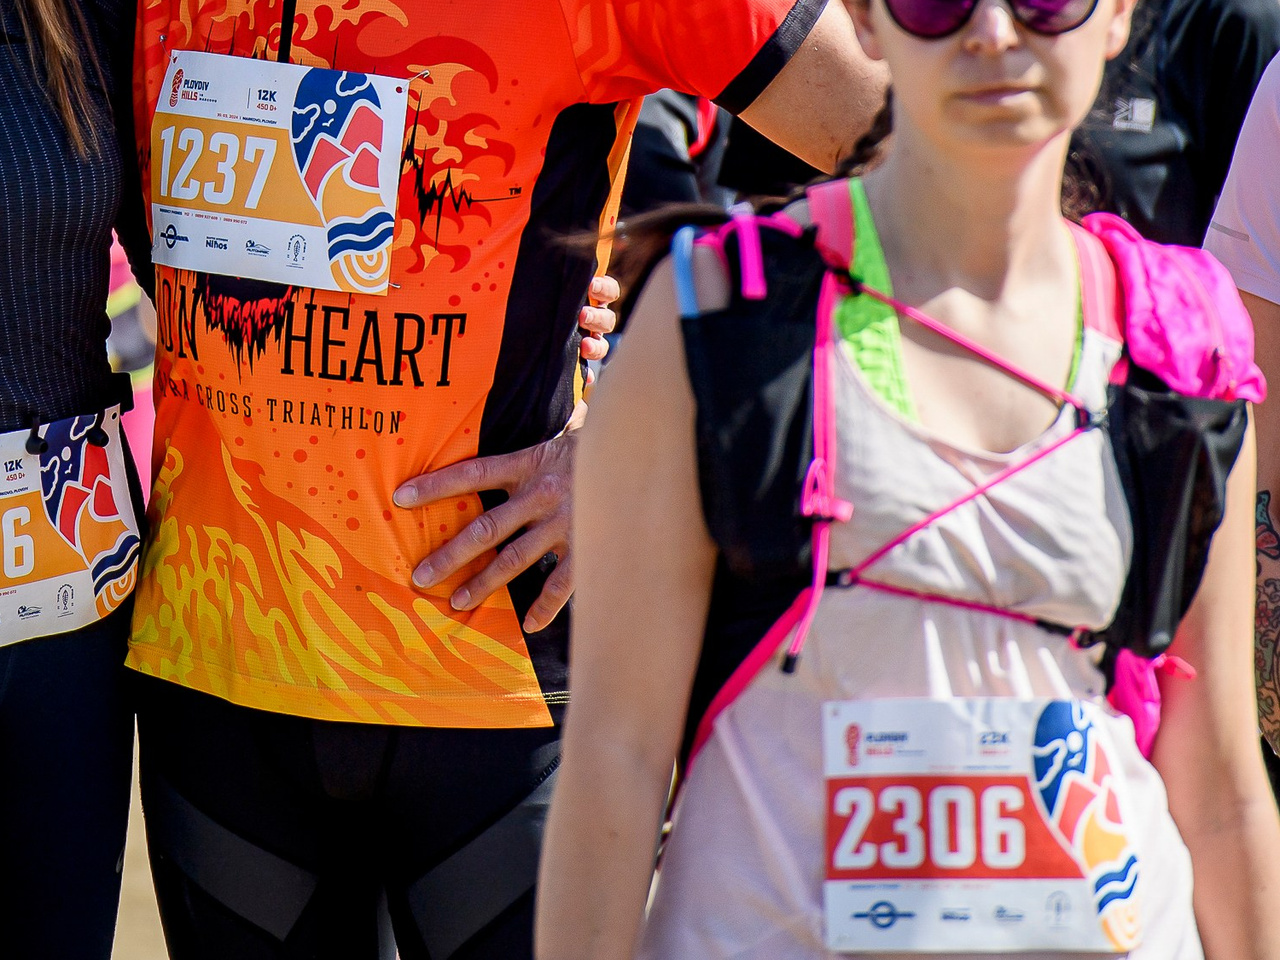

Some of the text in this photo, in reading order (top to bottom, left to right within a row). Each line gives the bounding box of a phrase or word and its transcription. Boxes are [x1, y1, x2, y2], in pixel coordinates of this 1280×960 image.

[183, 79, 210, 91] PLOVDIV
[181, 90, 198, 101] HILLS
[257, 89, 277, 102] 12K
[256, 103, 268, 111] 450
[160, 125, 277, 210] 1237
[280, 300, 468, 387] HEART
[196, 383, 252, 418] CROSS
[266, 398, 403, 435] TRIATHLON
[4, 458, 24, 473] 12K
[6, 473, 18, 482] 450
[832, 784, 1026, 871] 2306
